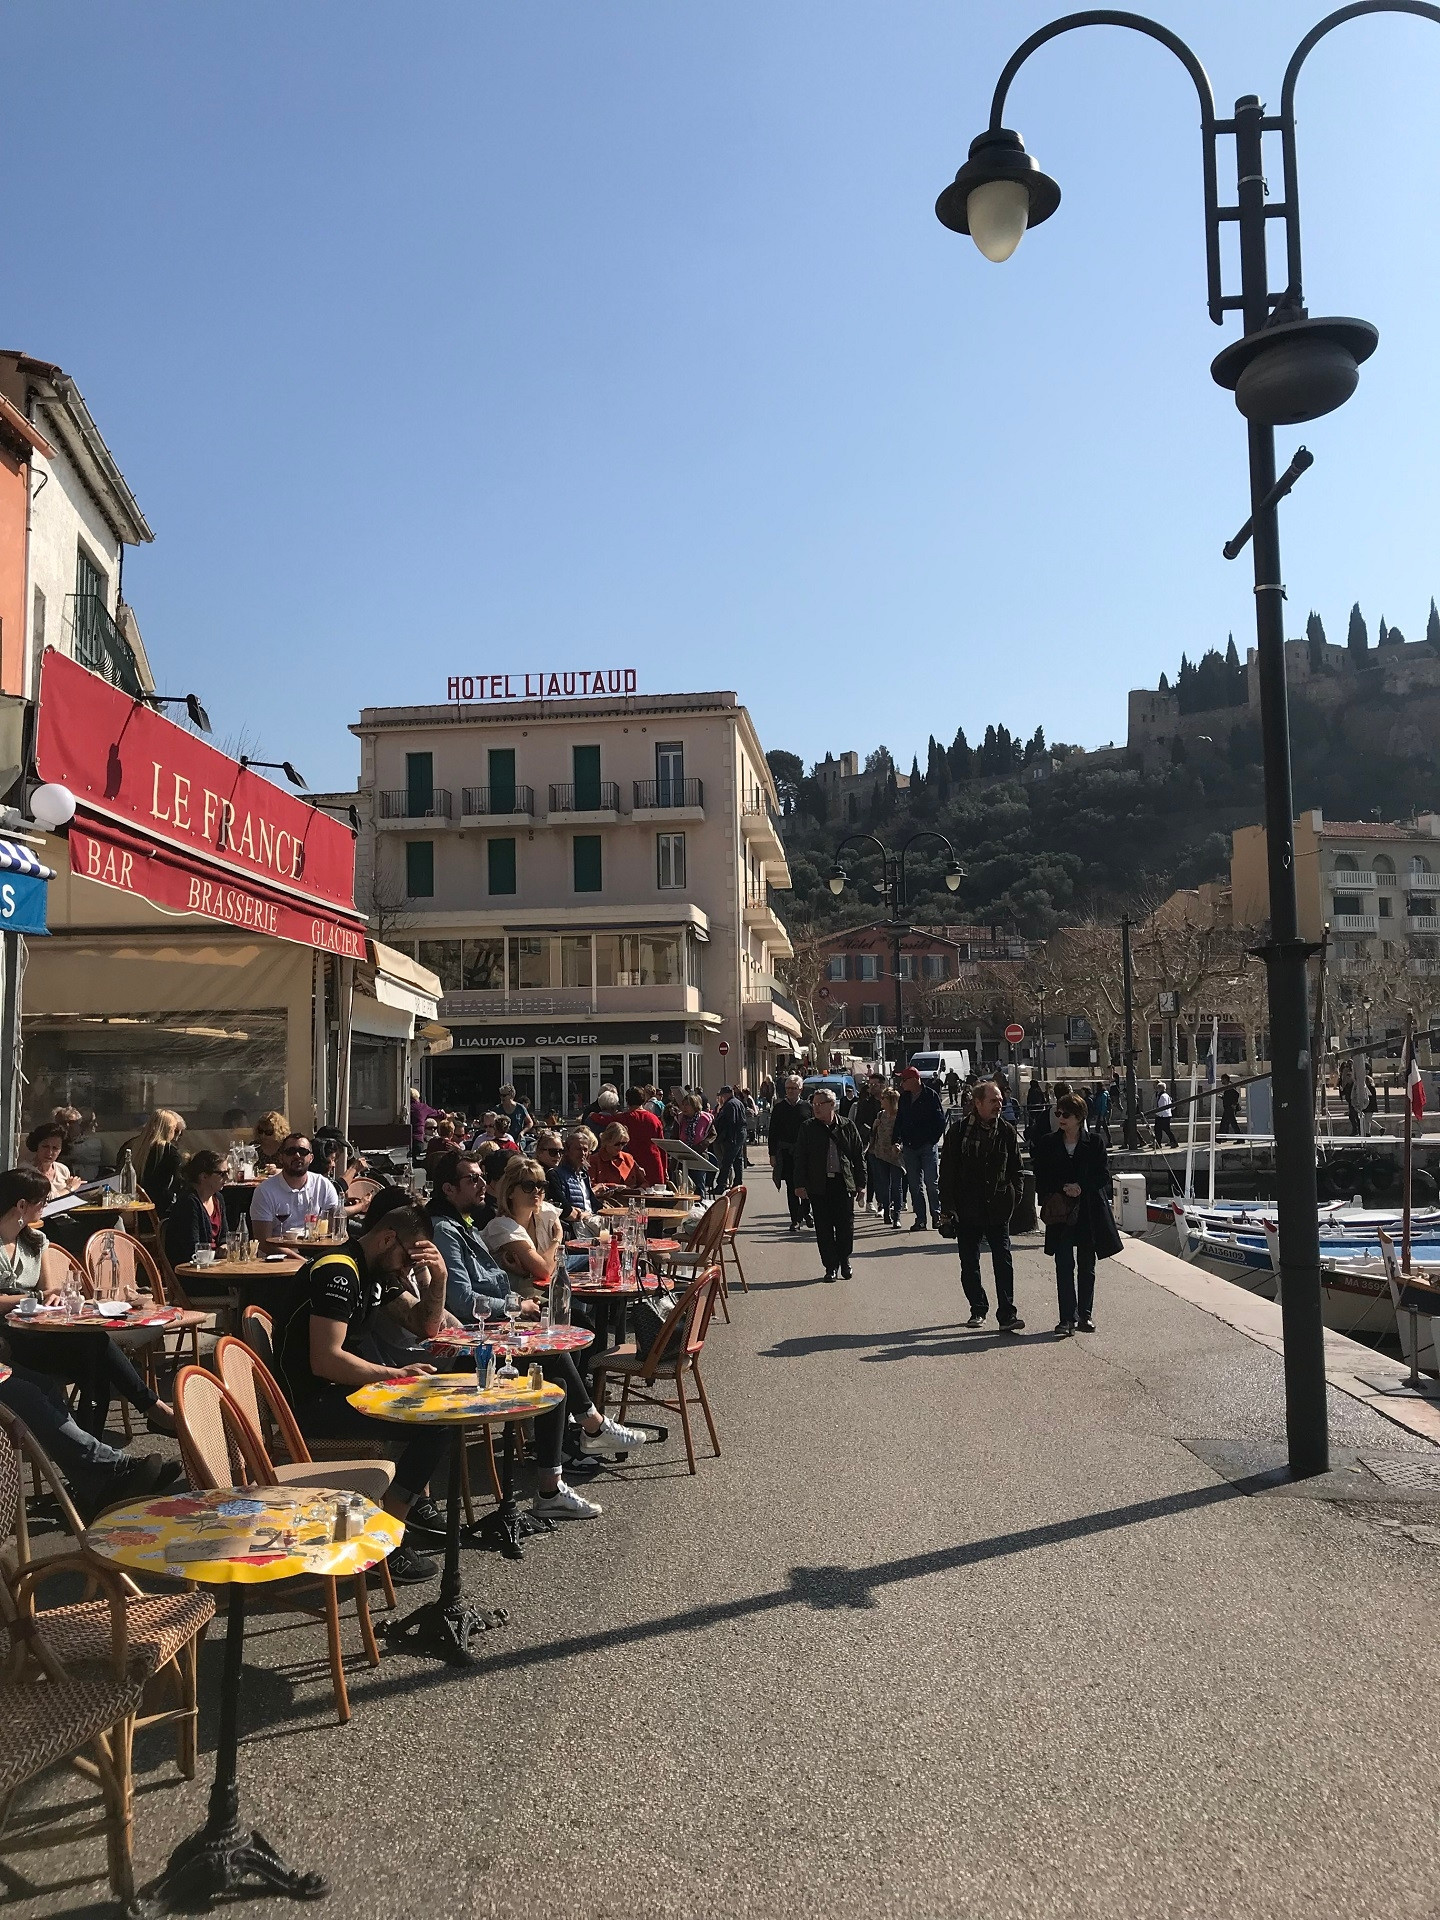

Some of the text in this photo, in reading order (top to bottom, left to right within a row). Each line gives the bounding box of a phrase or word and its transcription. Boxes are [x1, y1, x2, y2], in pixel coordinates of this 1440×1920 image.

[448, 669, 637, 699] HOTEL LIAUTAUD
[150, 761, 304, 882] LE FRANCE
[0, 884, 16, 918] S
[86, 837, 359, 956] BAR BRASSERIE GLACIER
[459, 1035, 598, 1047] LIAUTAUD GLACIER
